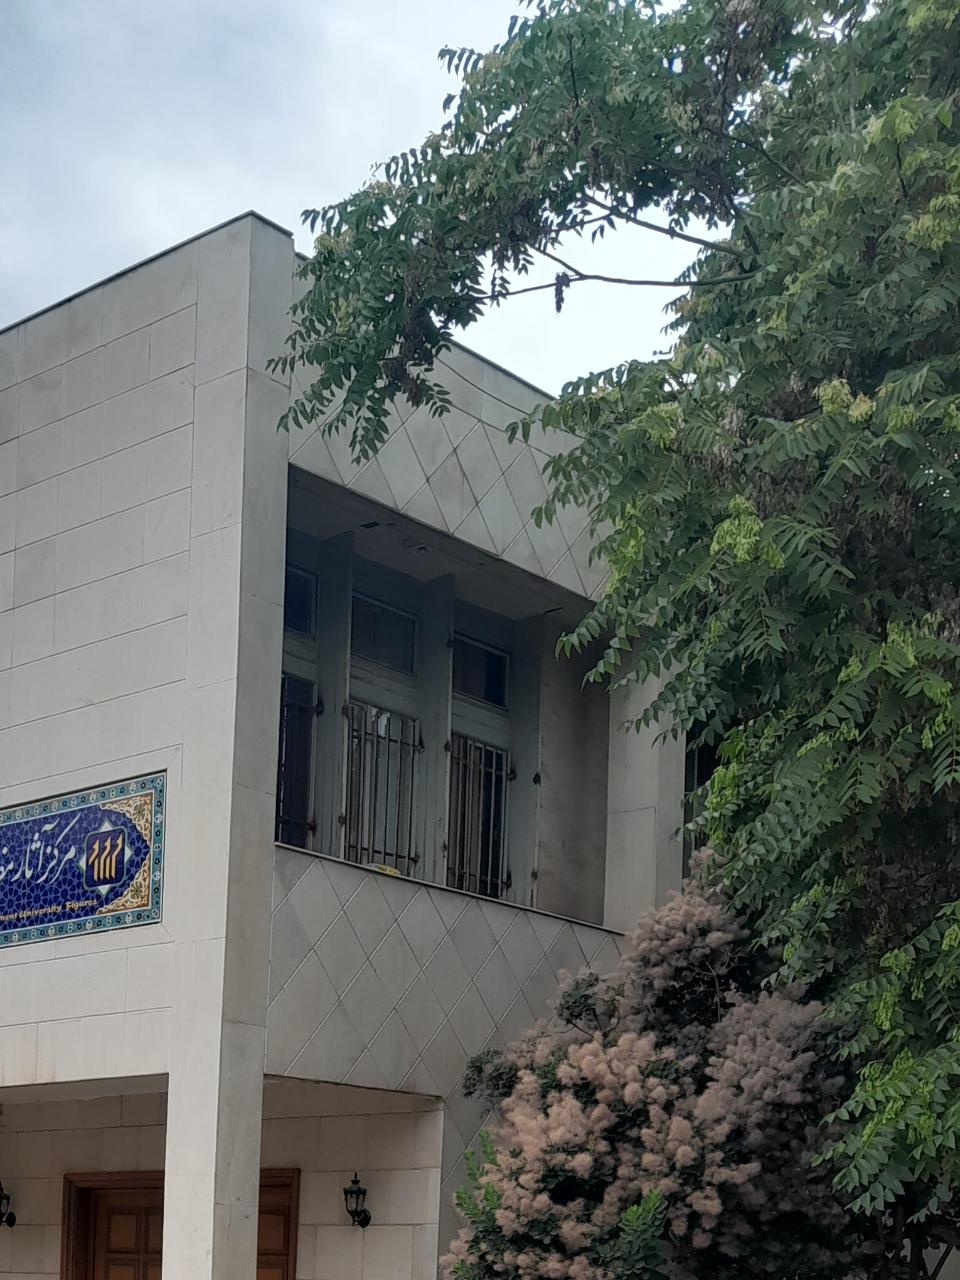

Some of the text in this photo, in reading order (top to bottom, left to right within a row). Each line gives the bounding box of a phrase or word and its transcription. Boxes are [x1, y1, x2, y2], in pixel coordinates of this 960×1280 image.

[36, 811, 81, 885] مرکز
[18, 904, 62, 919] University
[65, 898, 98, 911] Figures
